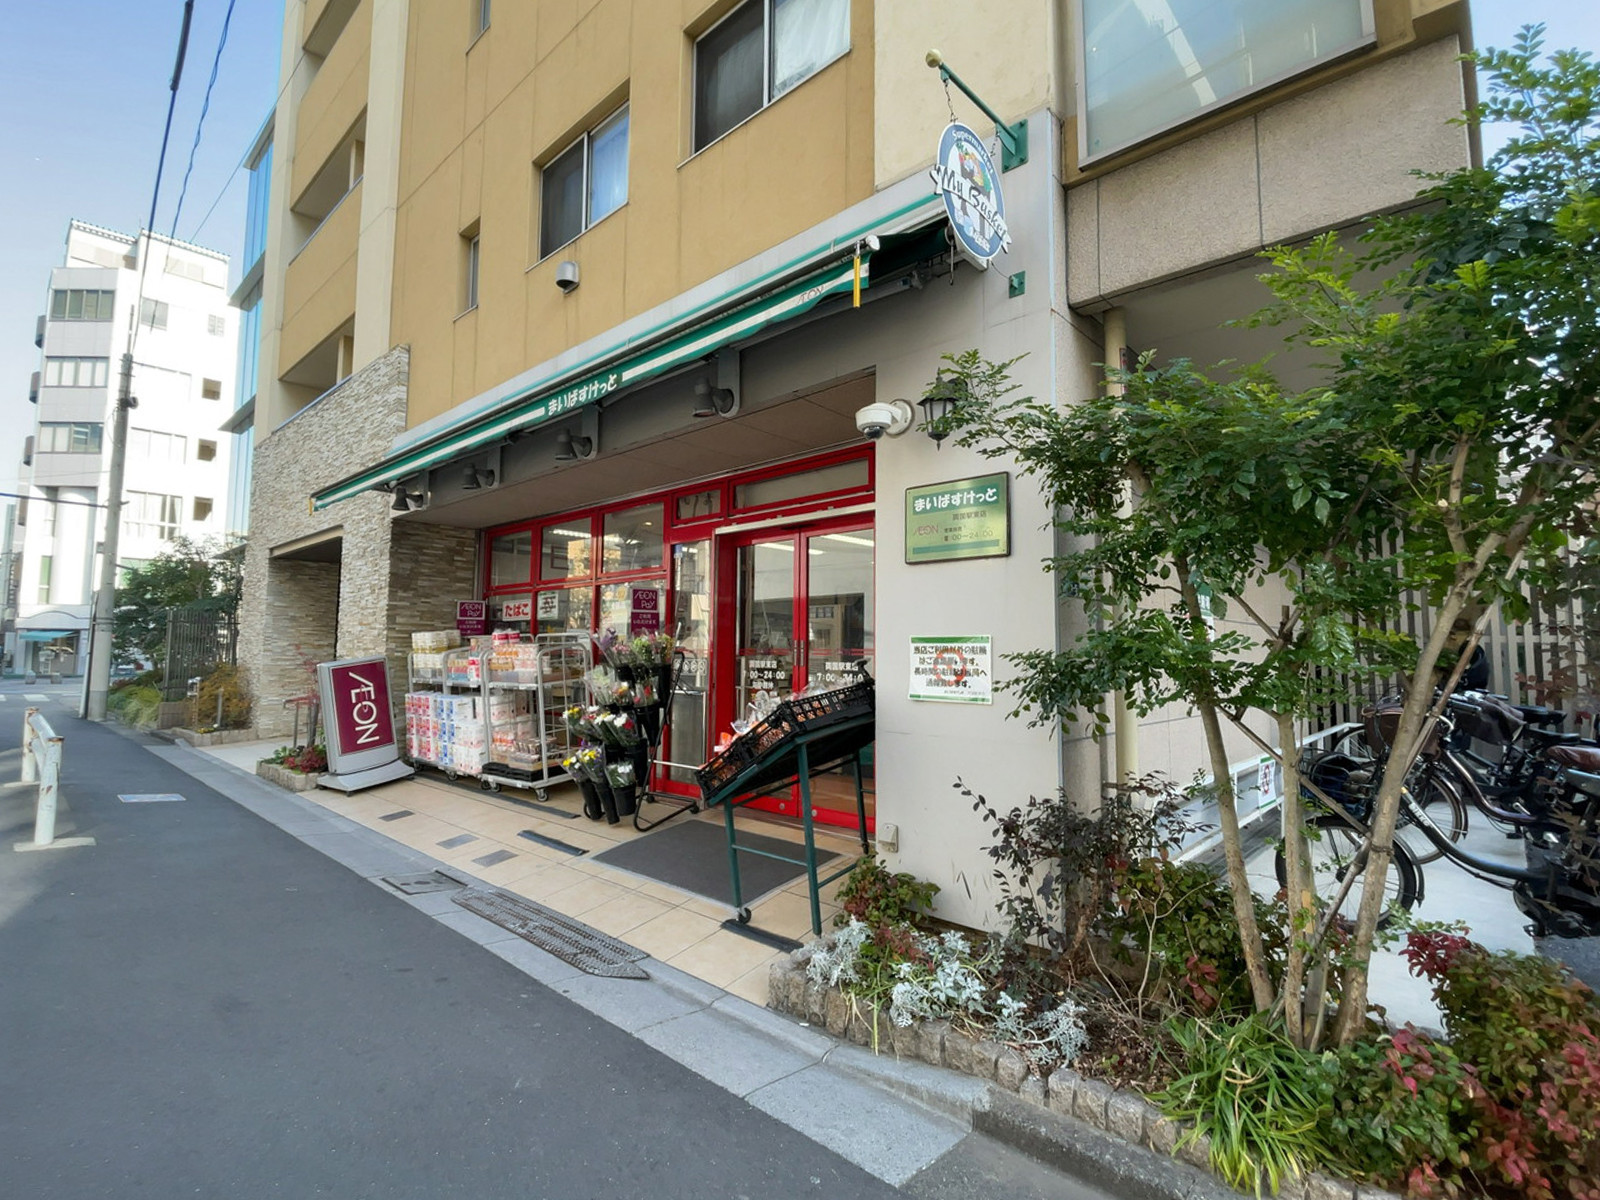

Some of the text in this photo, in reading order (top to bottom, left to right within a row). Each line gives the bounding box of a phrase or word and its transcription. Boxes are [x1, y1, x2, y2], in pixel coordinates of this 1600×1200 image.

[548, 374, 617, 415] まいばすけっと
[914, 488, 997, 512] まいばすけっと
[504, 603, 529, 617] たばこ
